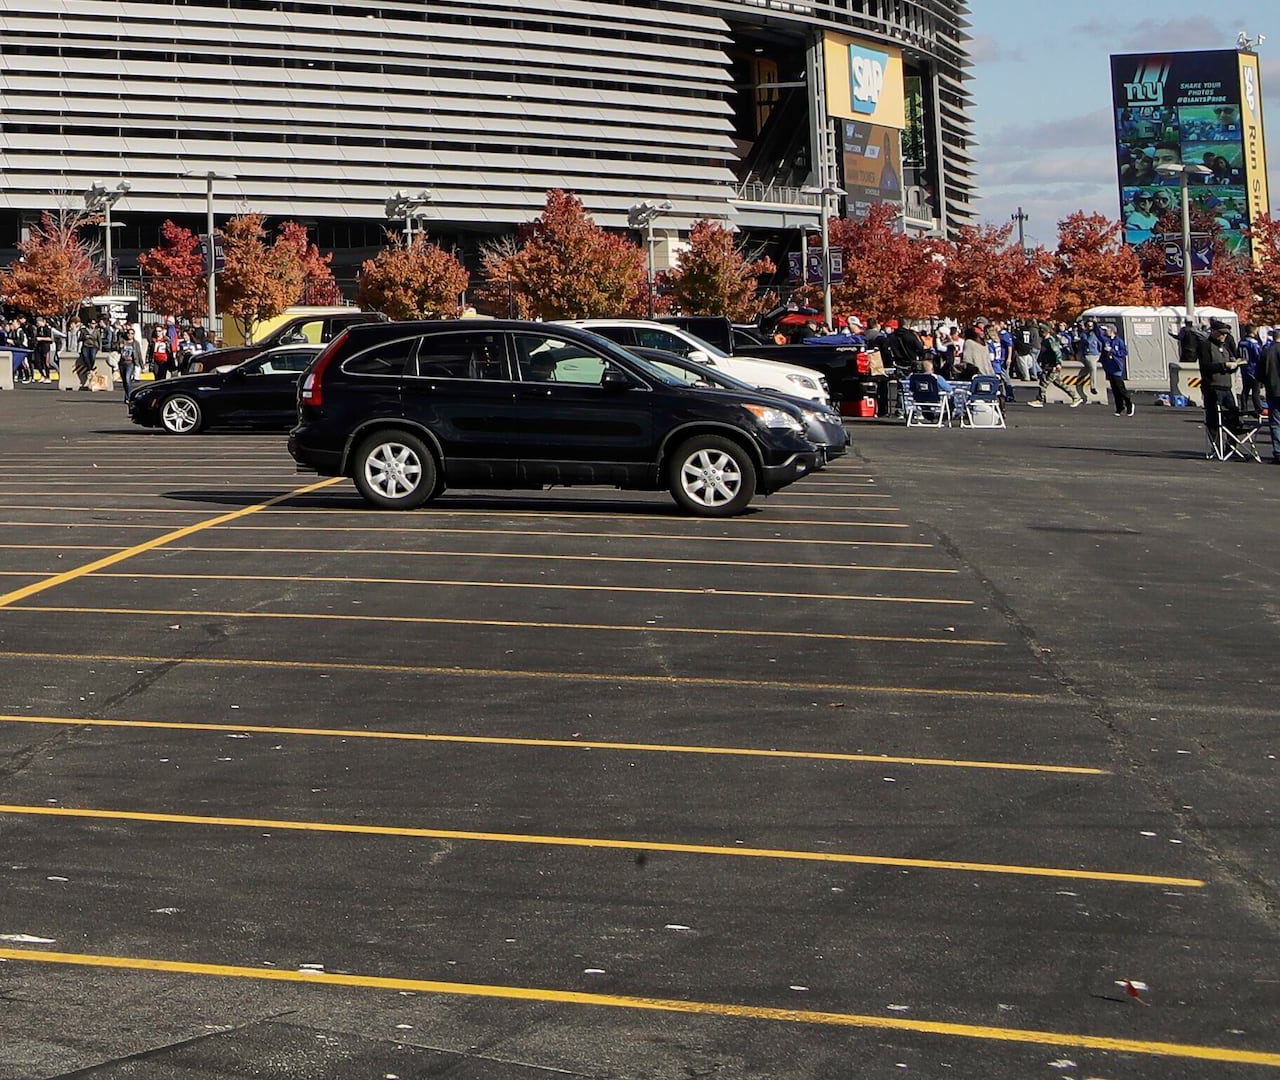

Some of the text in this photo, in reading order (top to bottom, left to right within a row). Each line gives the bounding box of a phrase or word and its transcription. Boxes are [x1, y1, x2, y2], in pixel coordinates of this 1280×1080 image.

[852, 56, 883, 104] SAP
[1244, 66, 1254, 110] SAP
[1248, 125, 1256, 169] Run
